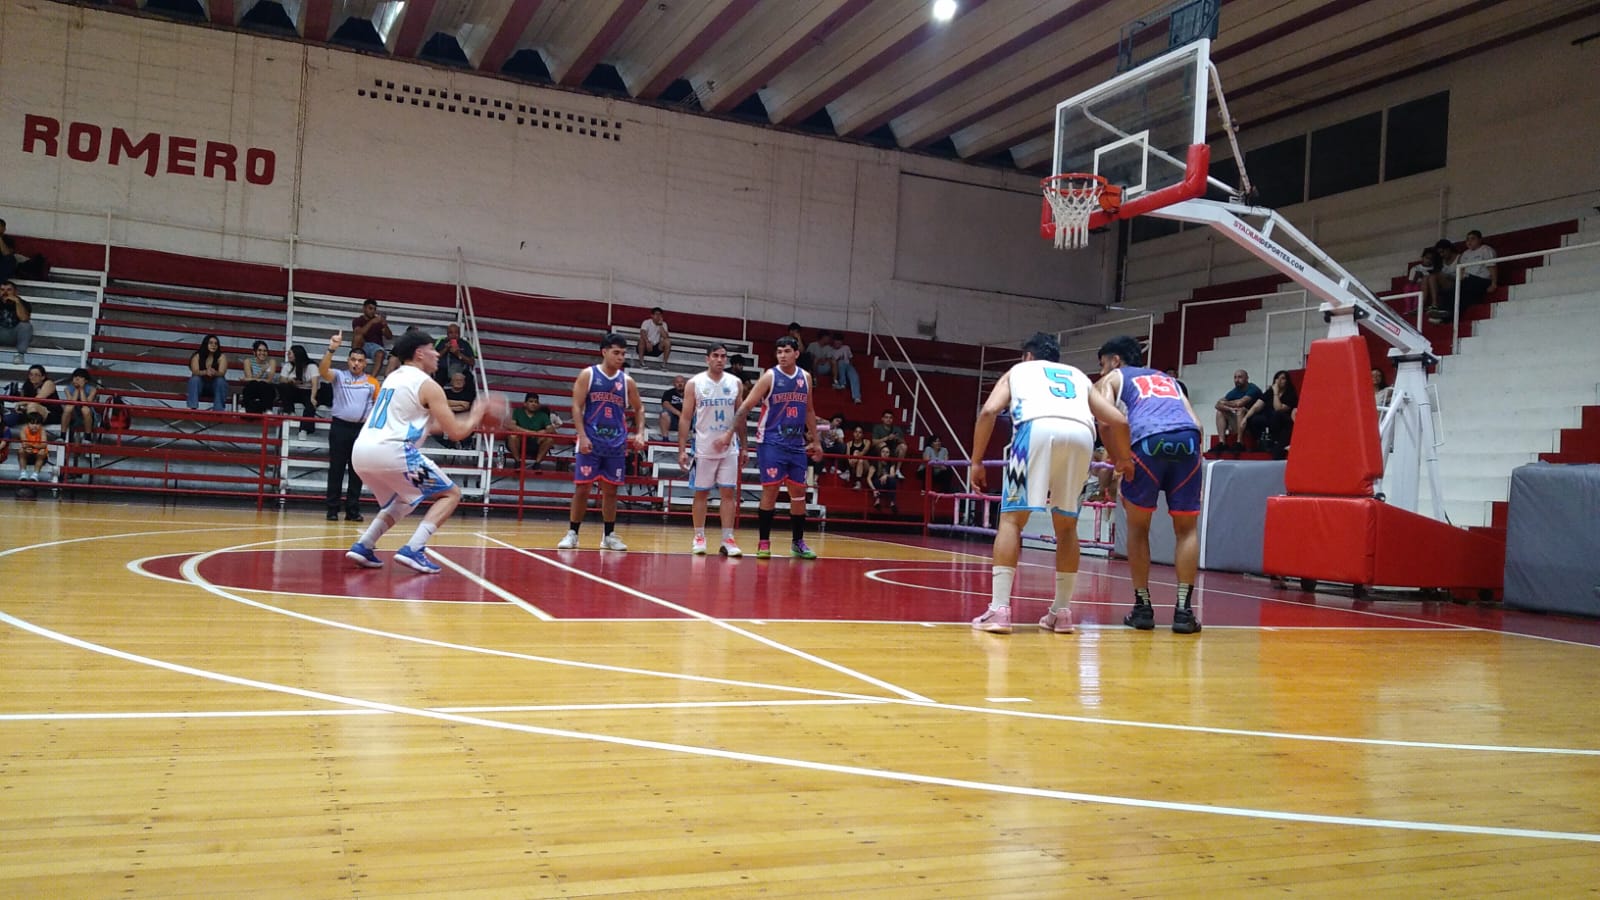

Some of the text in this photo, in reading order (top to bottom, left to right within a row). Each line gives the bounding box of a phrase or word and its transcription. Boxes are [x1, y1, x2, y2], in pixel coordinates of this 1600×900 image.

[22, 114, 276, 185] ROMERO
[1043, 366, 1077, 399] 5
[1132, 374, 1180, 400] 15
[715, 409, 725, 422] 14
